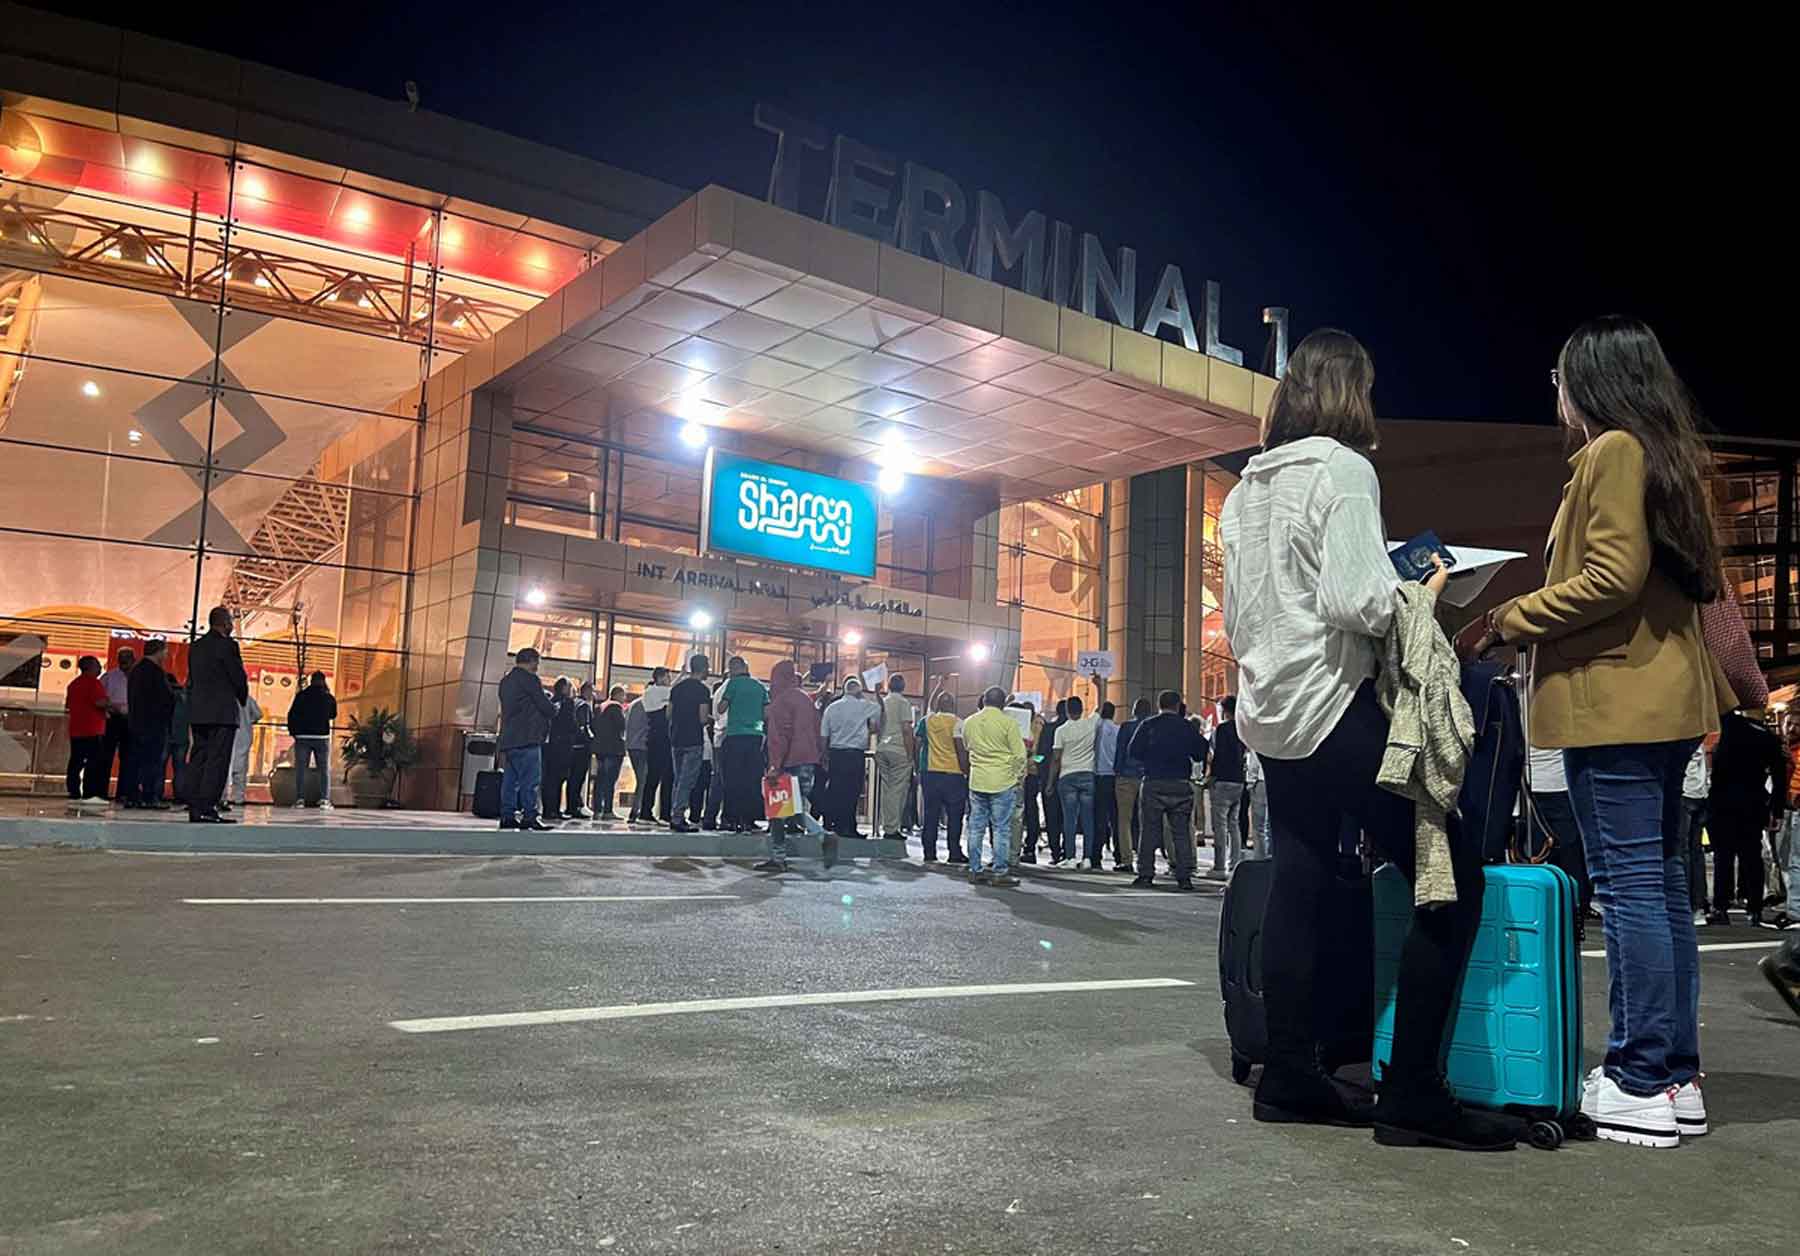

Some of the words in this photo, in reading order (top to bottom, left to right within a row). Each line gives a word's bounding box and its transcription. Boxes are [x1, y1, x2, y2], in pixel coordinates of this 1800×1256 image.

[754, 103, 1243, 367] TERMINAL
[1263, 306, 1288, 379] 1
[637, 560, 666, 580] INT
[672, 568, 745, 592] ARRIVAL
